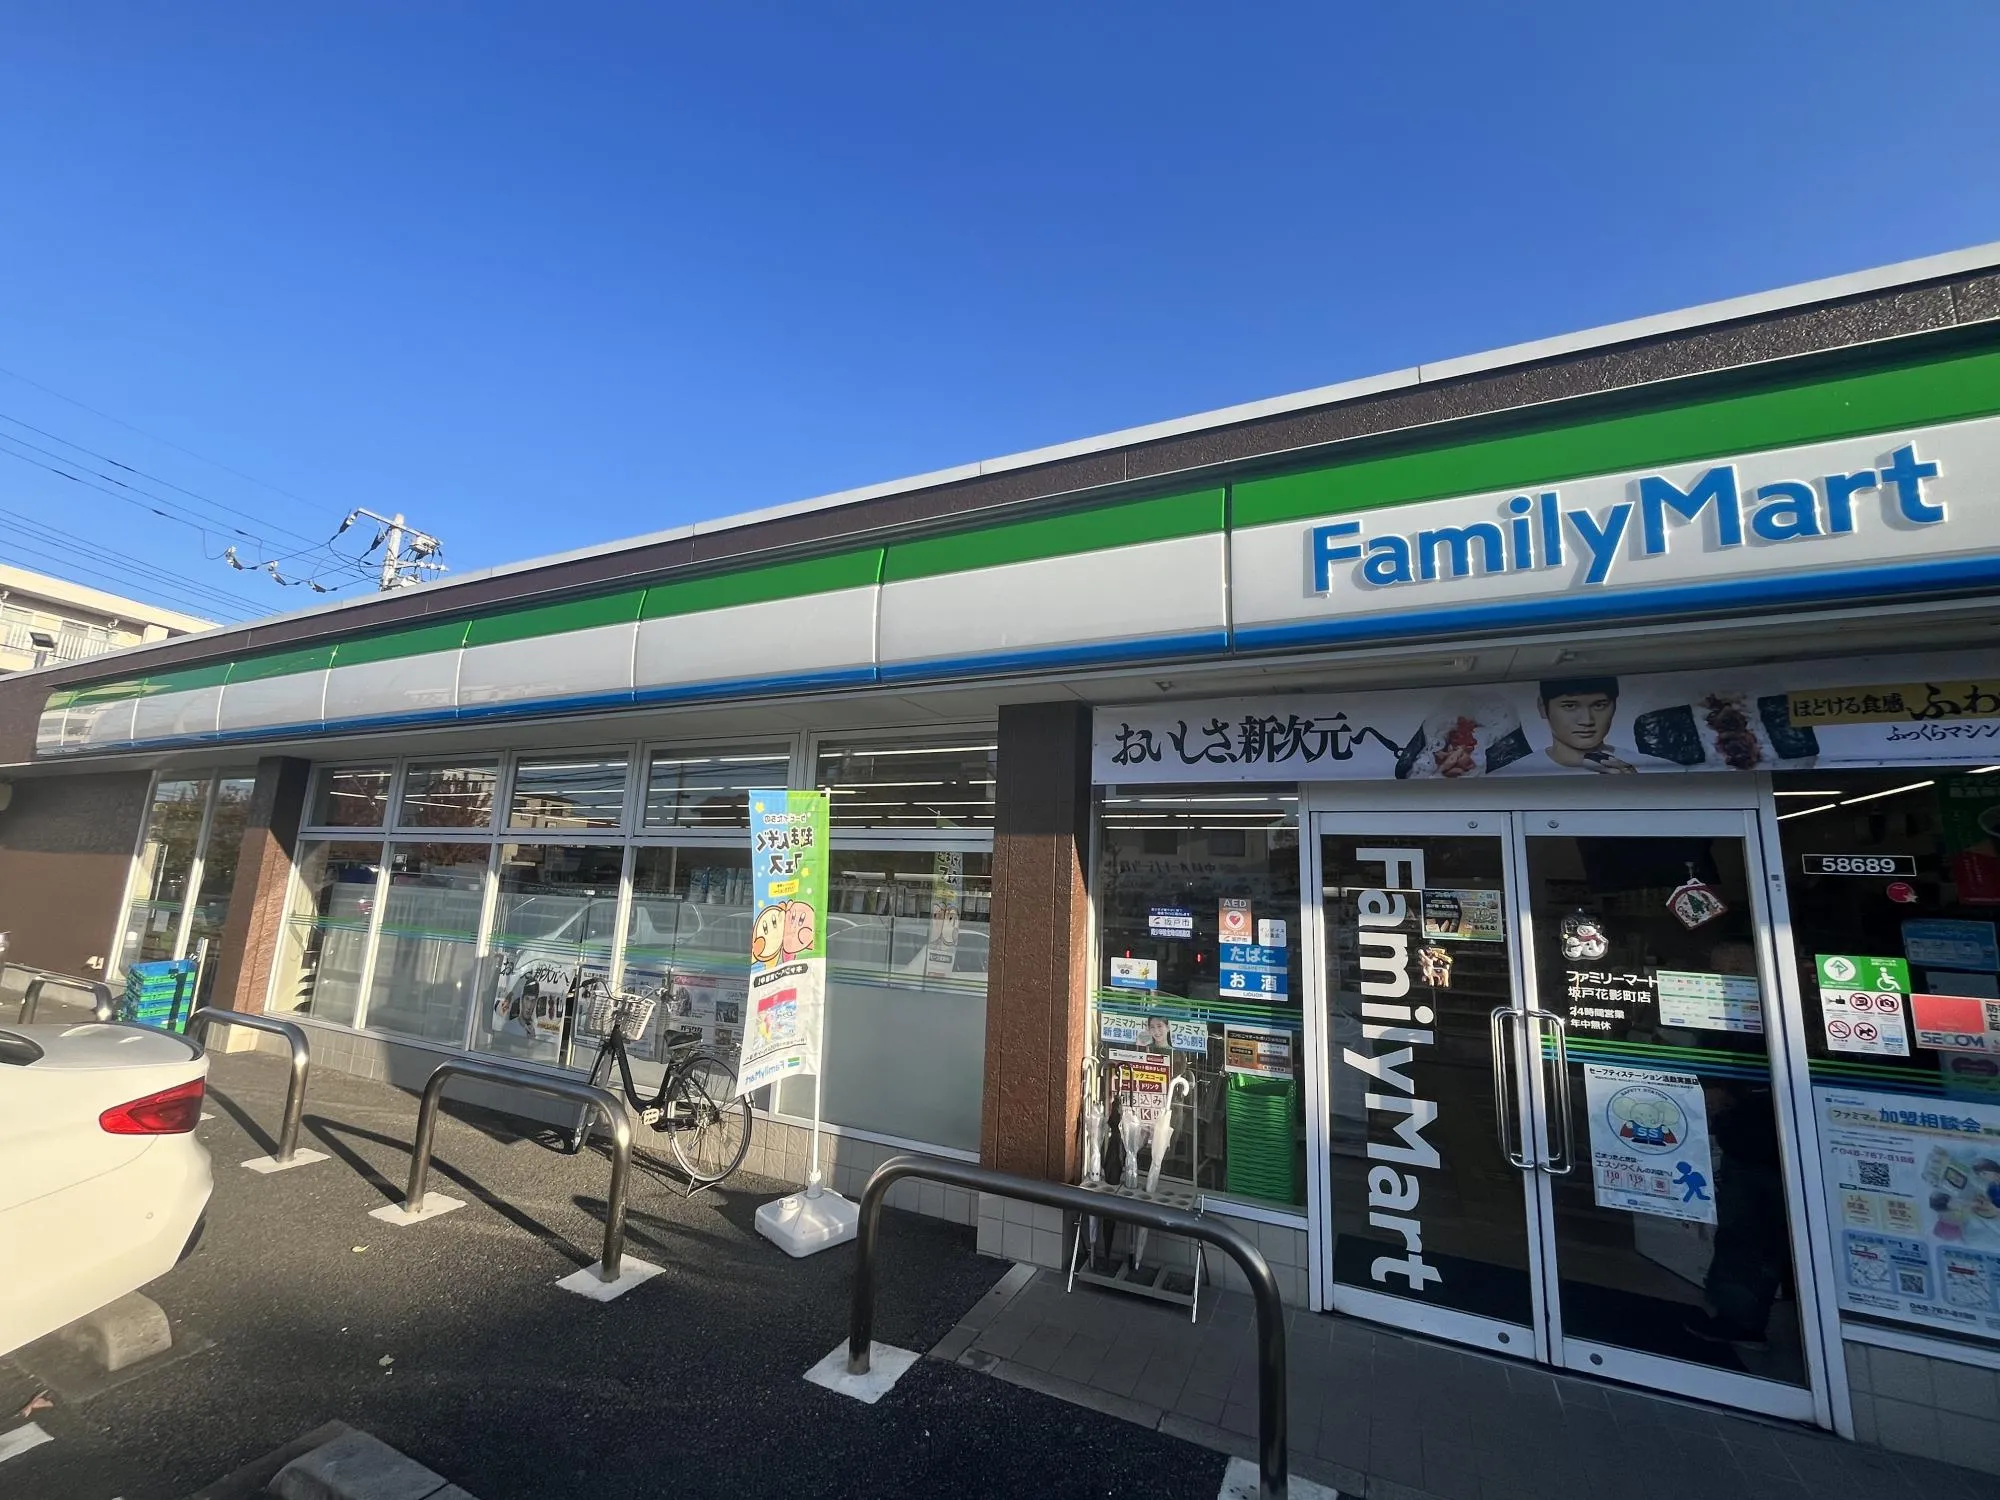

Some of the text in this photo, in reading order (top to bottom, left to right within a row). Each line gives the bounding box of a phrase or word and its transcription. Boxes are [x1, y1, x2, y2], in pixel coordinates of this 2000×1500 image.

[1311, 441, 1949, 597] FamilyMart
[1112, 711, 1402, 766] おいしさ新次元へ
[1821, 857, 1896, 874] 58689
[1223, 899, 1247, 908] AED
[1230, 946, 1276, 964] たばこ
[1566, 970, 1658, 988] ファミリーマート
[1568, 986, 1651, 1004] 坂戸花影町店
[1569, 1006, 1625, 1020] 24時間営業
[1103, 1015, 1148, 1029] ファミマカード
[1172, 1023, 1206, 1037] ファミマで
[1570, 1019, 1612, 1031] 年中無休
[1921, 1031, 1985, 1049] SECOM
[1343, 847, 1444, 1291] FamilyMart
[1141, 1082, 1160, 1090] ドリンク
[1879, 1108, 1982, 1134] 加盟相談会
[1637, 1127, 1660, 1138] SS
